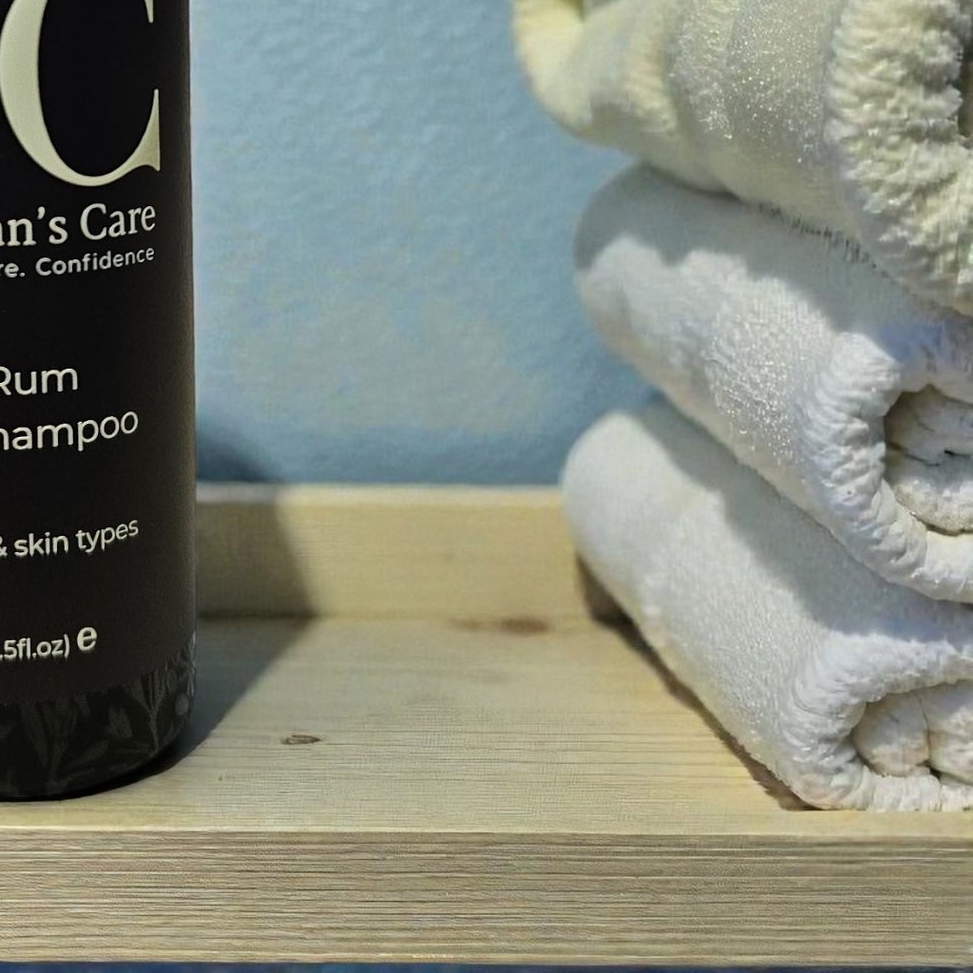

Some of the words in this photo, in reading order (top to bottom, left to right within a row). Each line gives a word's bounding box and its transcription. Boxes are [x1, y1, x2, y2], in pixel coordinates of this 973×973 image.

[79, 202, 156, 241] Care
[34, 247, 155, 277] Confidence
[13, 532, 69, 558] skin
[74, 519, 140, 554] types
